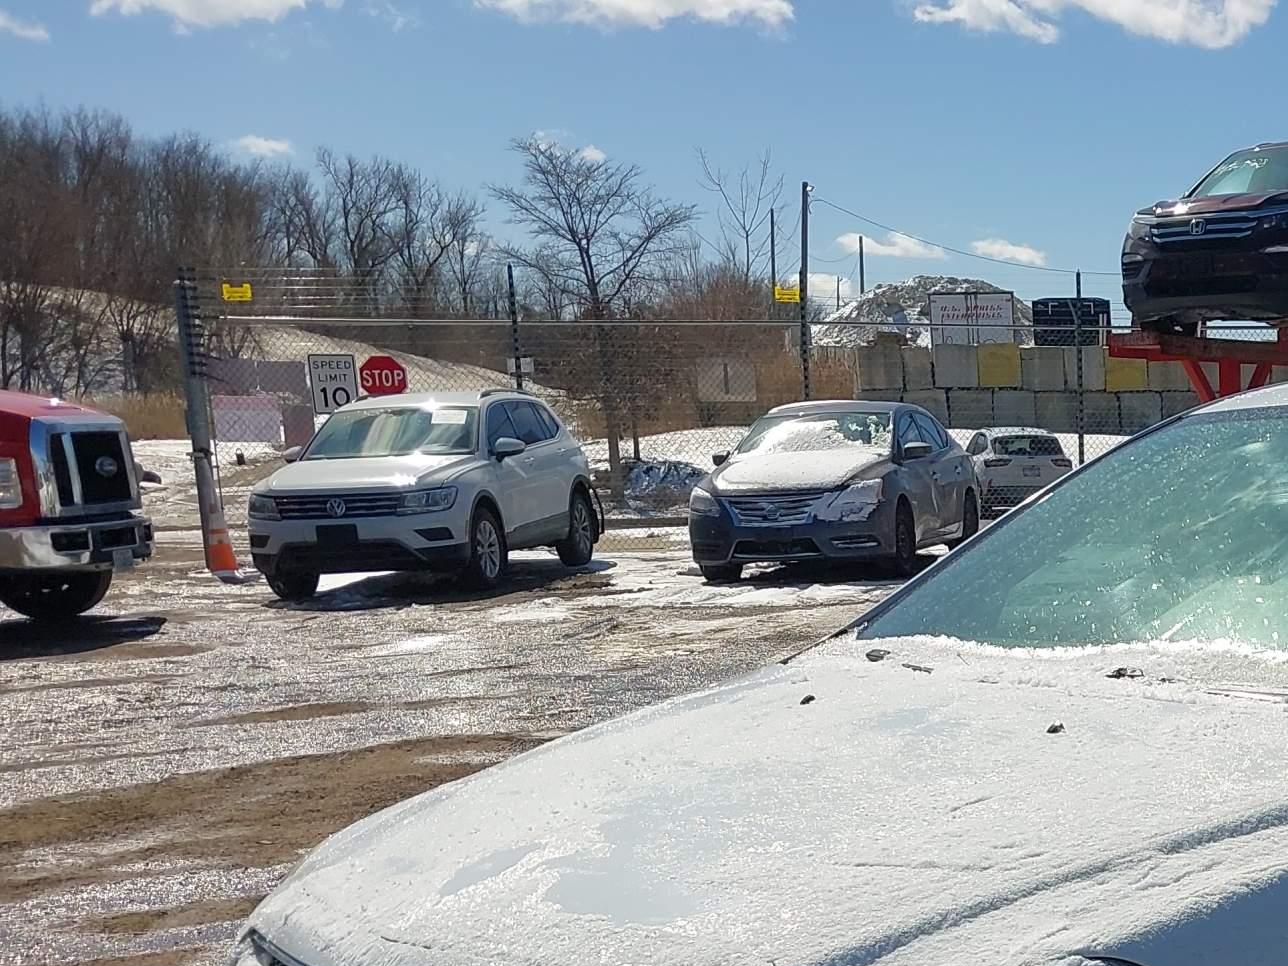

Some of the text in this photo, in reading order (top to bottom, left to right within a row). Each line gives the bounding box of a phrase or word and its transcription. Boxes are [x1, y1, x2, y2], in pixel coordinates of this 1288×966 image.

[312, 360, 351, 370] SPEED
[318, 373, 348, 383] LIMIT
[362, 369, 404, 387] STOP
[319, 386, 351, 407] 10
